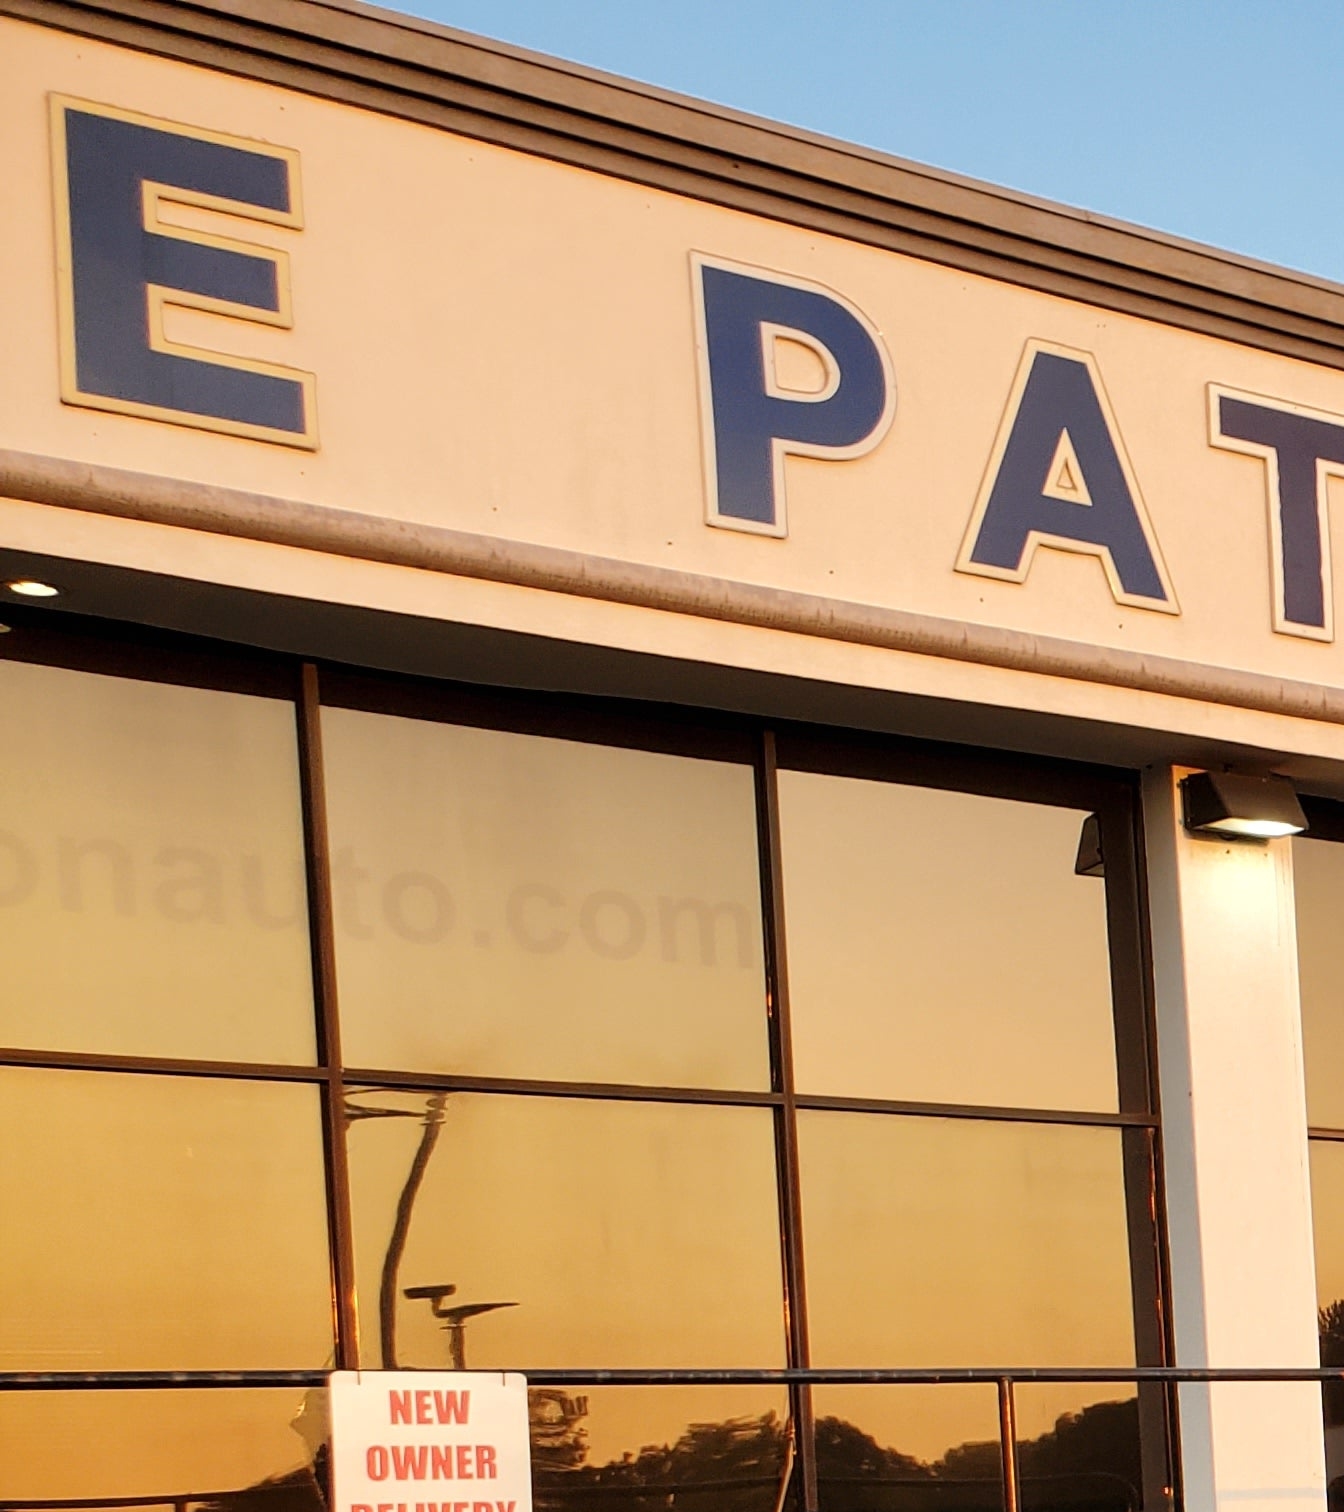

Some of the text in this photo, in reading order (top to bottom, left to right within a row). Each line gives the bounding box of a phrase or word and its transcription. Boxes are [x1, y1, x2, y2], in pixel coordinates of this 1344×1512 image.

[48, 91, 319, 452] E
[389, 1390, 471, 1425] NEW
[366, 1445, 498, 1481] OWNER
